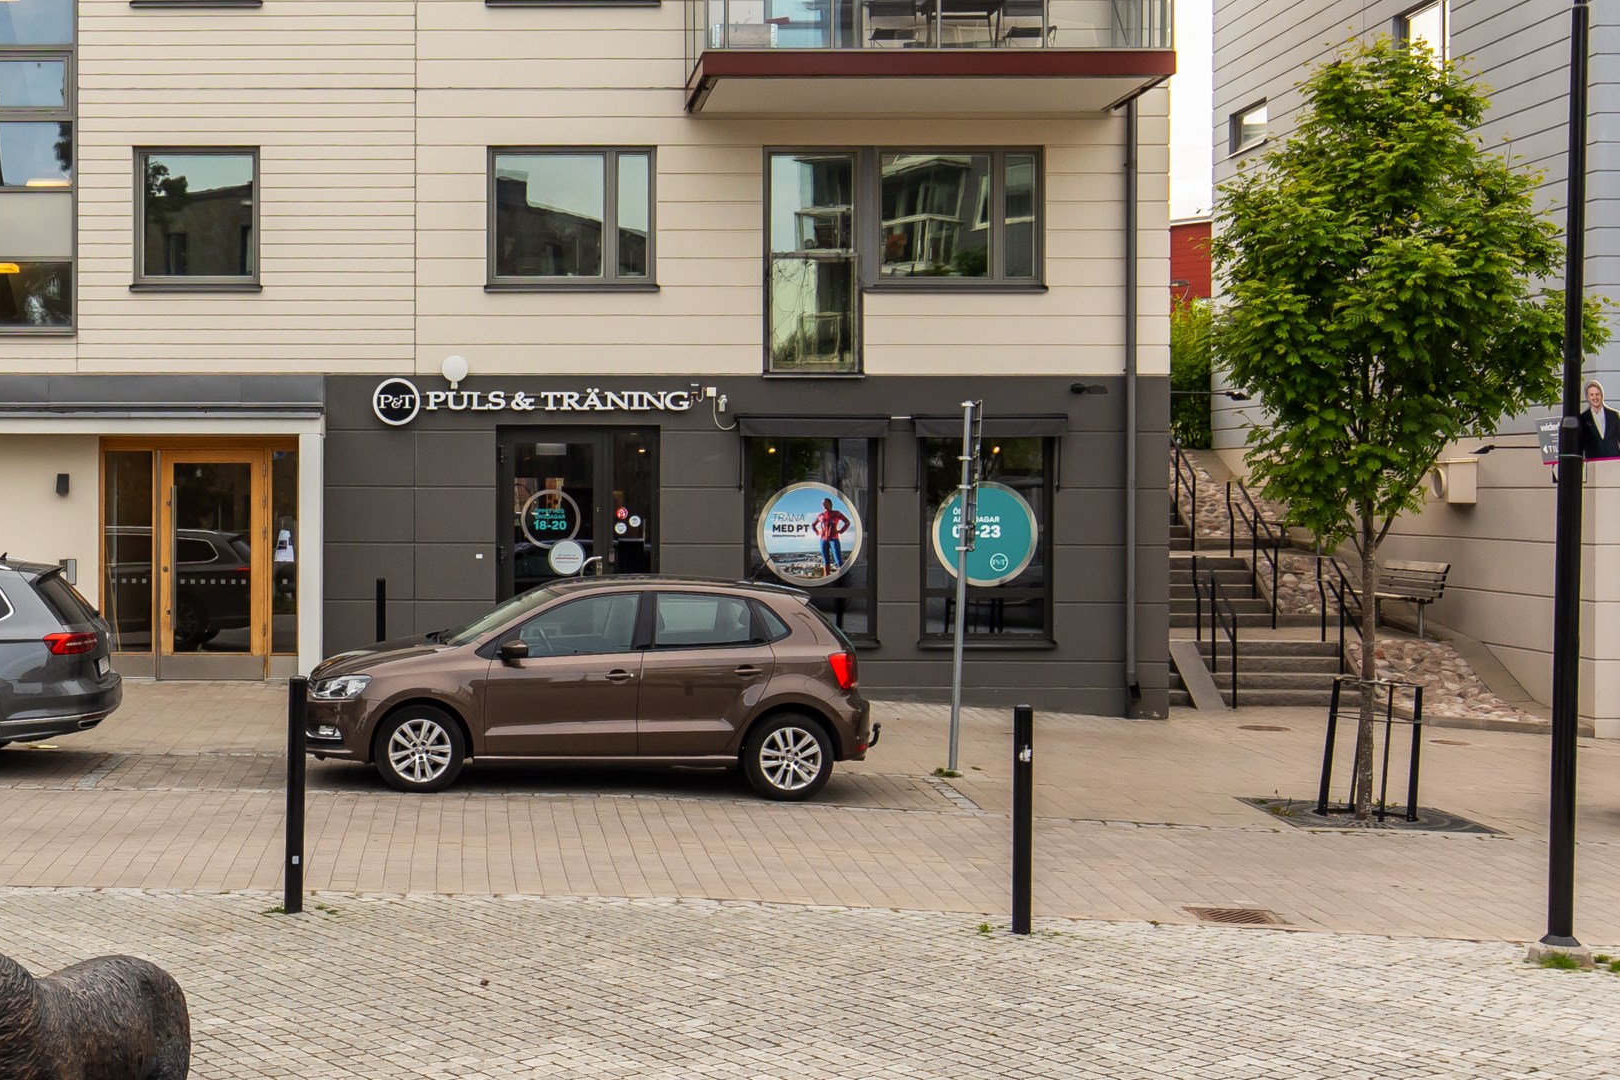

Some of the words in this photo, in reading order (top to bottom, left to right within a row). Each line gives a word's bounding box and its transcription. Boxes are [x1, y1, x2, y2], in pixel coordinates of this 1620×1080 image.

[378, 394, 415, 409] P&T
[426, 391, 507, 411] PULS
[510, 391, 535, 411] &
[540, 387, 690, 411] TRÄNING
[533, 520, 567, 530] 18-20
[772, 524, 795, 533] MED
[796, 524, 810, 533] PT
[952, 524, 1001, 538] 0-23
